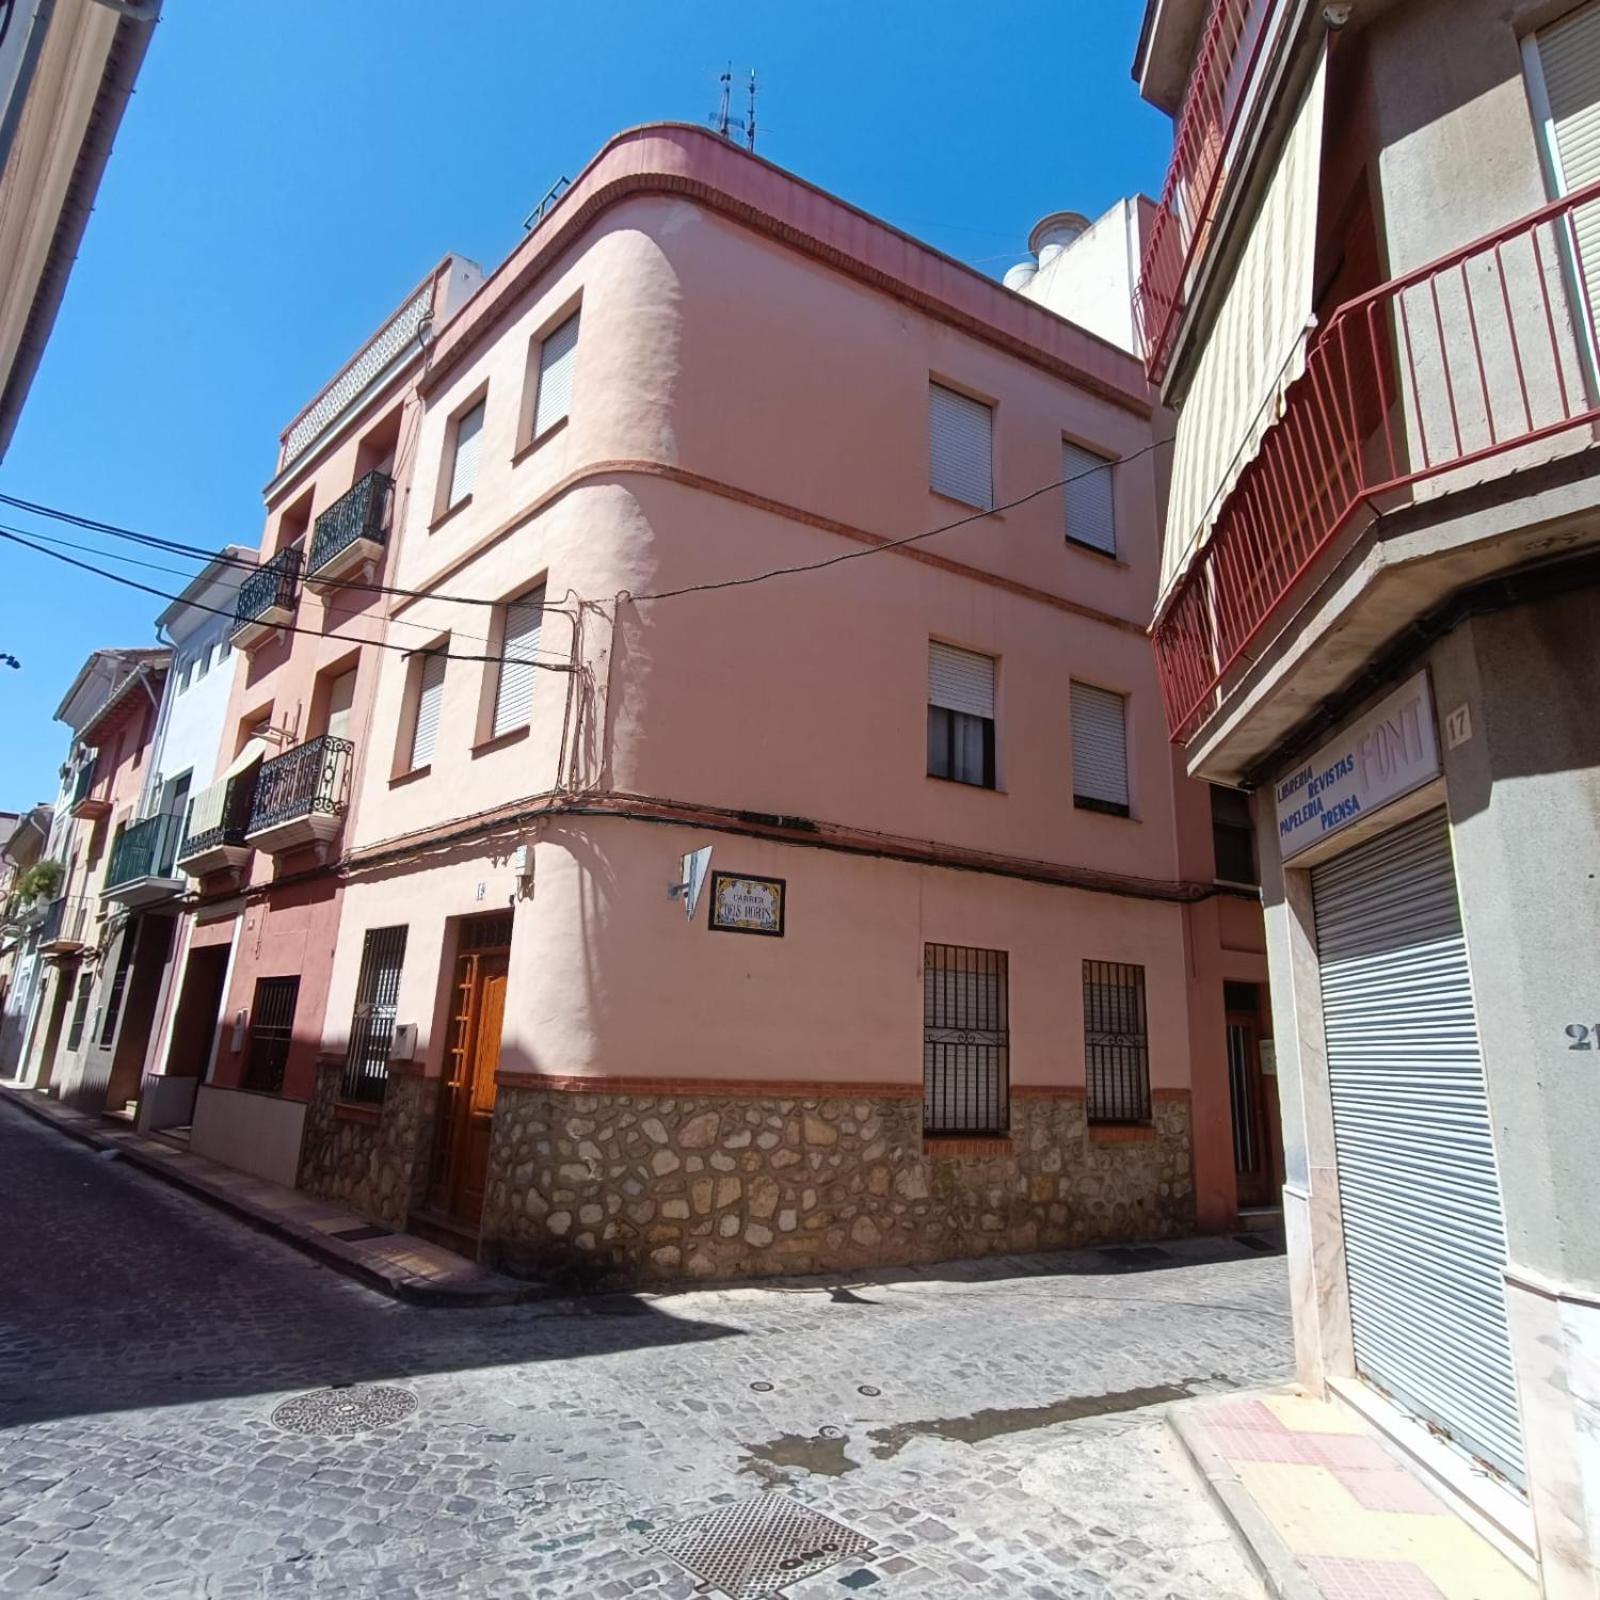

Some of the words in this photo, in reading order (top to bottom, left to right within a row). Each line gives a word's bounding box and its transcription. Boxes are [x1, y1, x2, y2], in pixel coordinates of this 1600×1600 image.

[1449, 711, 1464, 740] 17
[1359, 698, 1423, 793] FONT
[1308, 754, 1355, 798] REVISTAS
[1322, 795, 1361, 830] PRENSA
